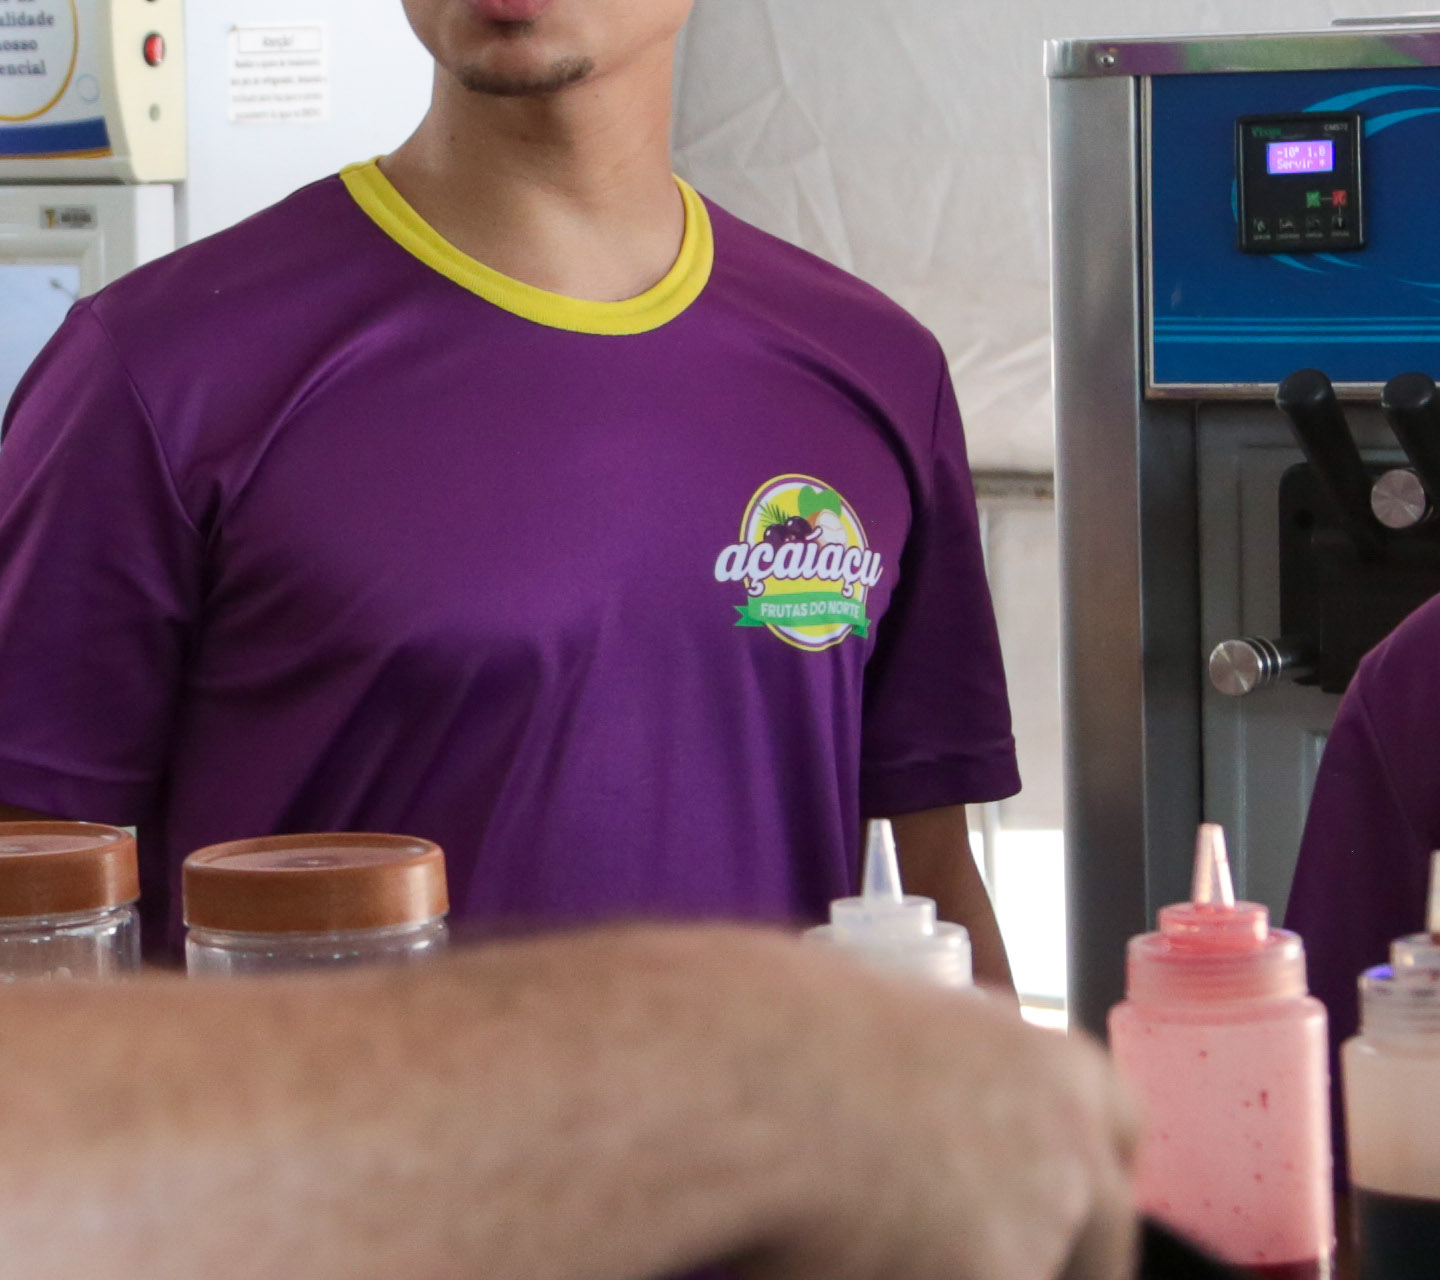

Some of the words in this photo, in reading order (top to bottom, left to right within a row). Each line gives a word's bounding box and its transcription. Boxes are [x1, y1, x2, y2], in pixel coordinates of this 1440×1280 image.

[714, 528, 882, 596] açaíaçu
[760, 601, 807, 618] FRUTAS
[809, 601, 827, 615] DO
[828, 601, 860, 619] NORTE
